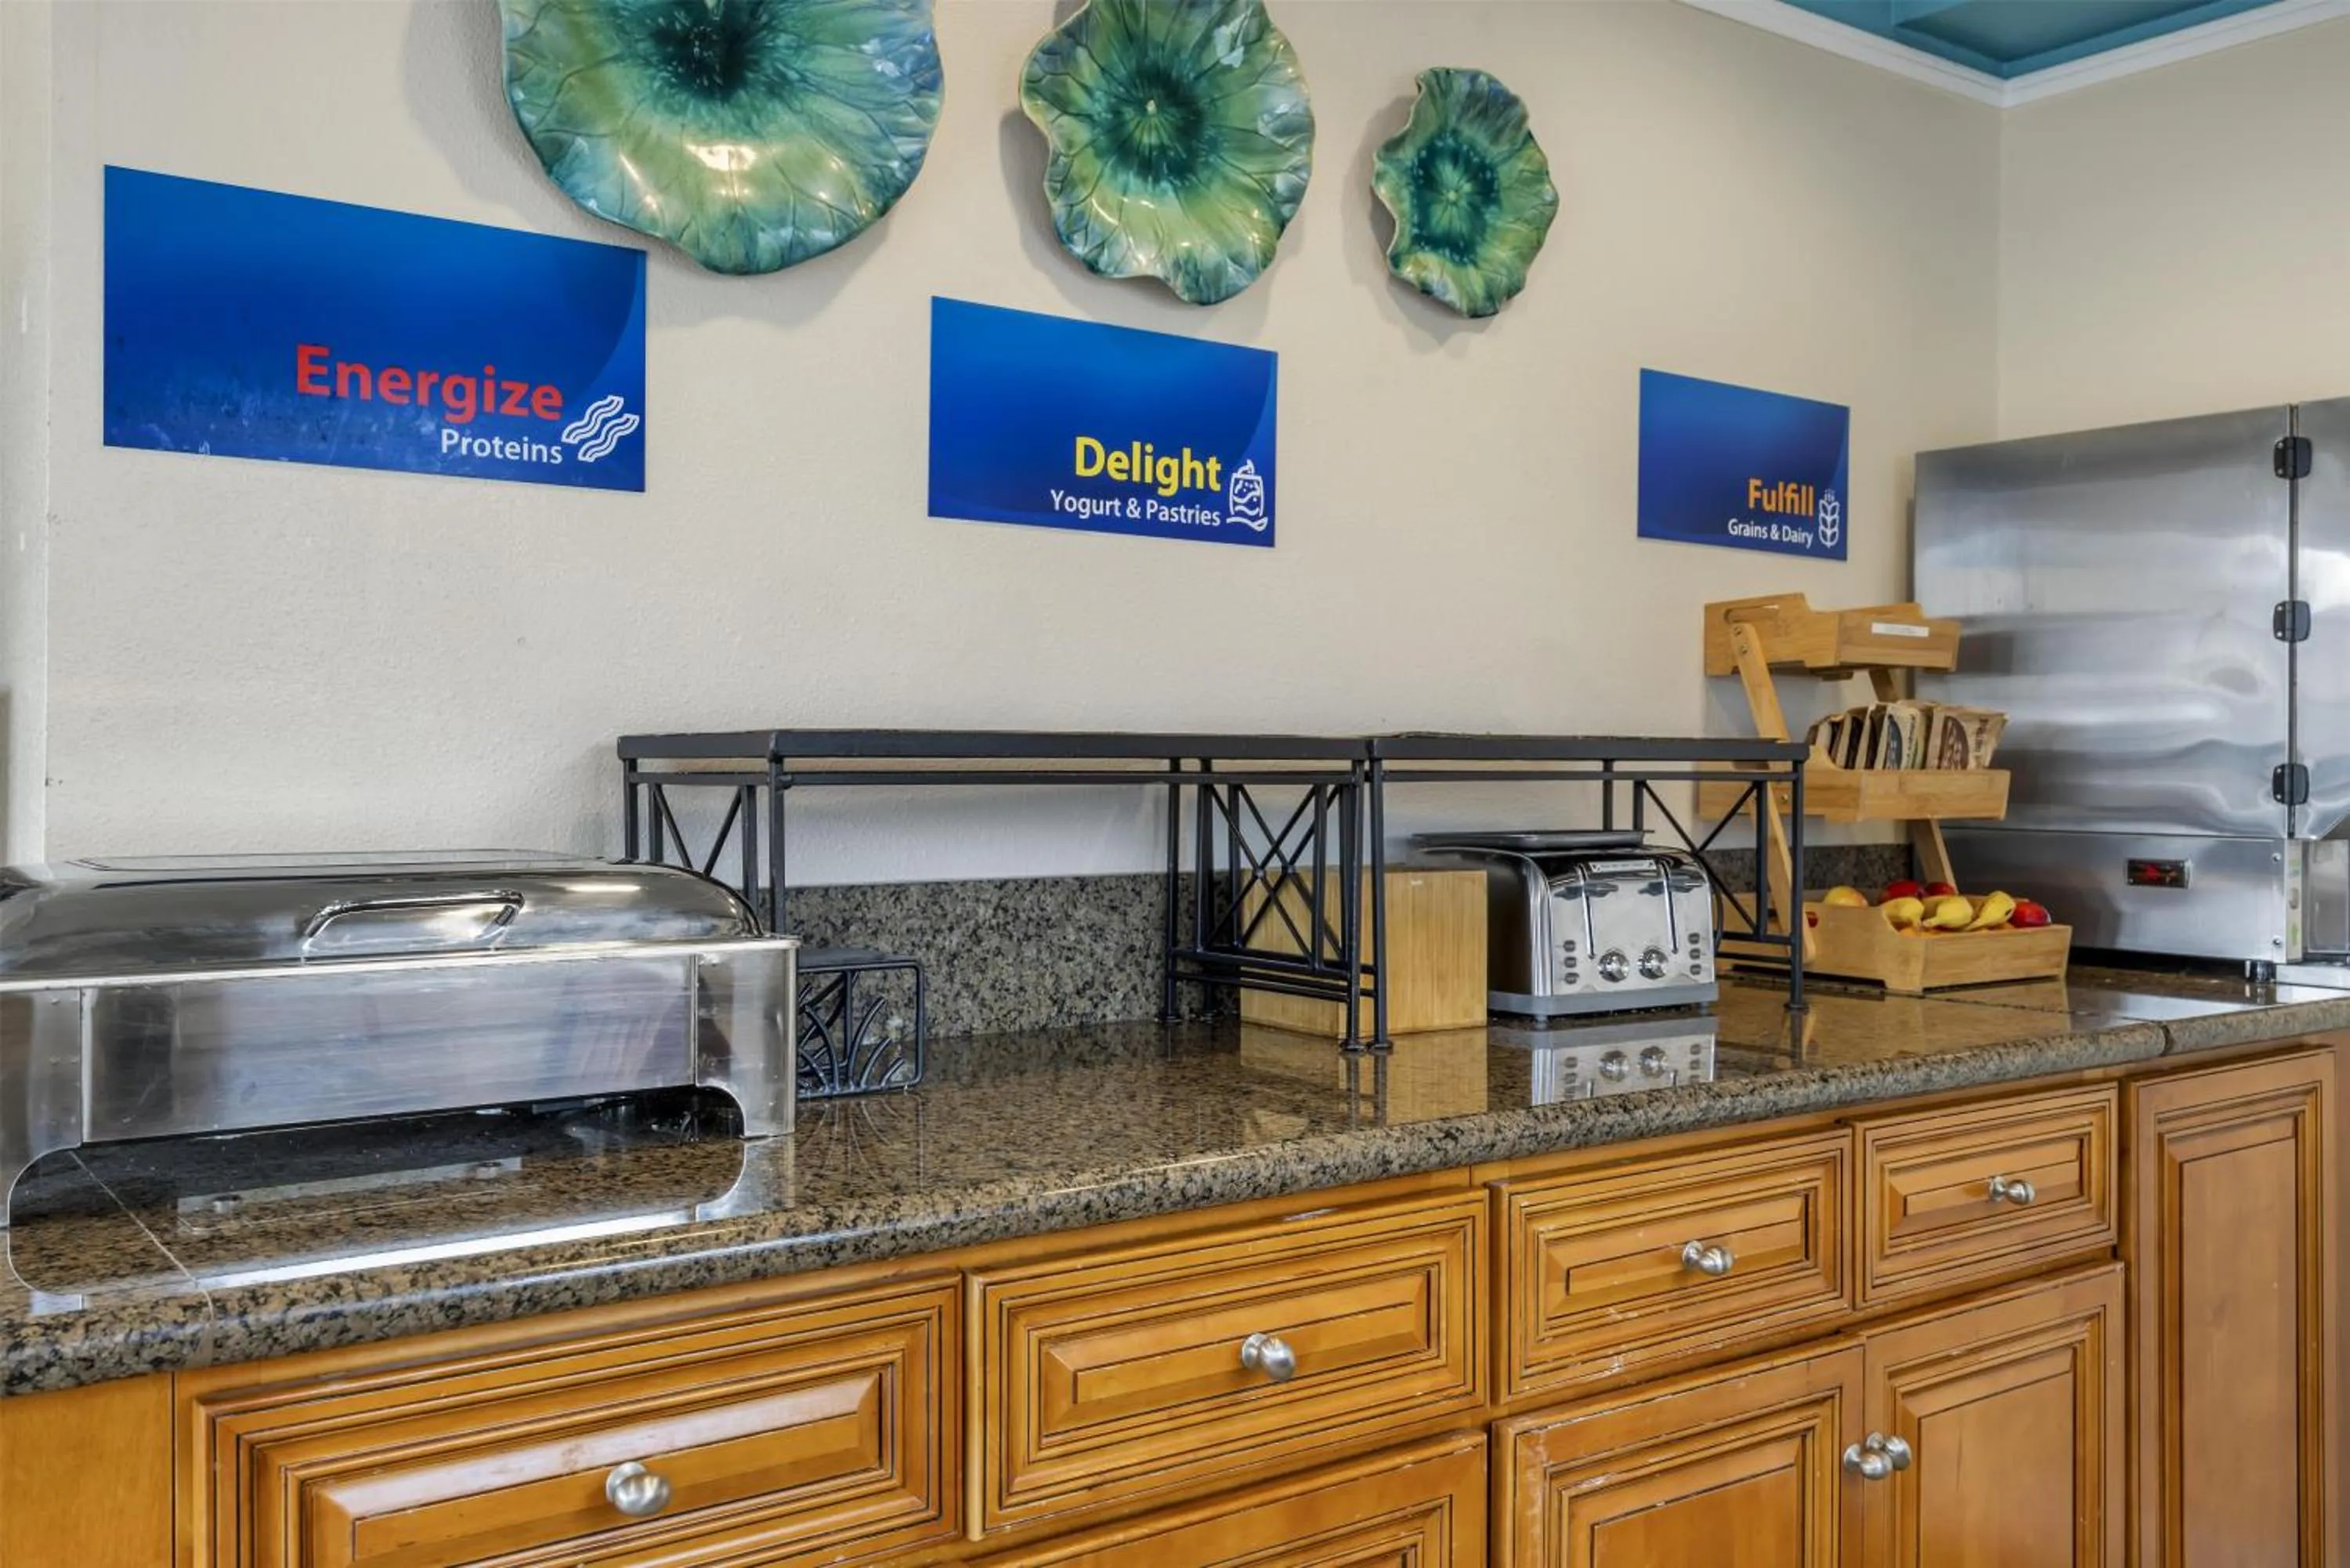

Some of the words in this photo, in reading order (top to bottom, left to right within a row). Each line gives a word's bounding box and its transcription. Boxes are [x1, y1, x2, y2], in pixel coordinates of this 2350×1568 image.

[297, 344, 563, 424] Energize
[441, 428, 563, 464] Proteins
[1075, 435, 1221, 497] Delight
[1050, 490, 1121, 519] Yogurt
[1126, 497, 1141, 519] &
[1146, 500, 1220, 526] Pastries
[1748, 478, 1813, 517] Fulfill
[1727, 518, 1768, 540] Grains
[1770, 523, 1780, 540] &
[1782, 526, 1813, 550] Dairy
